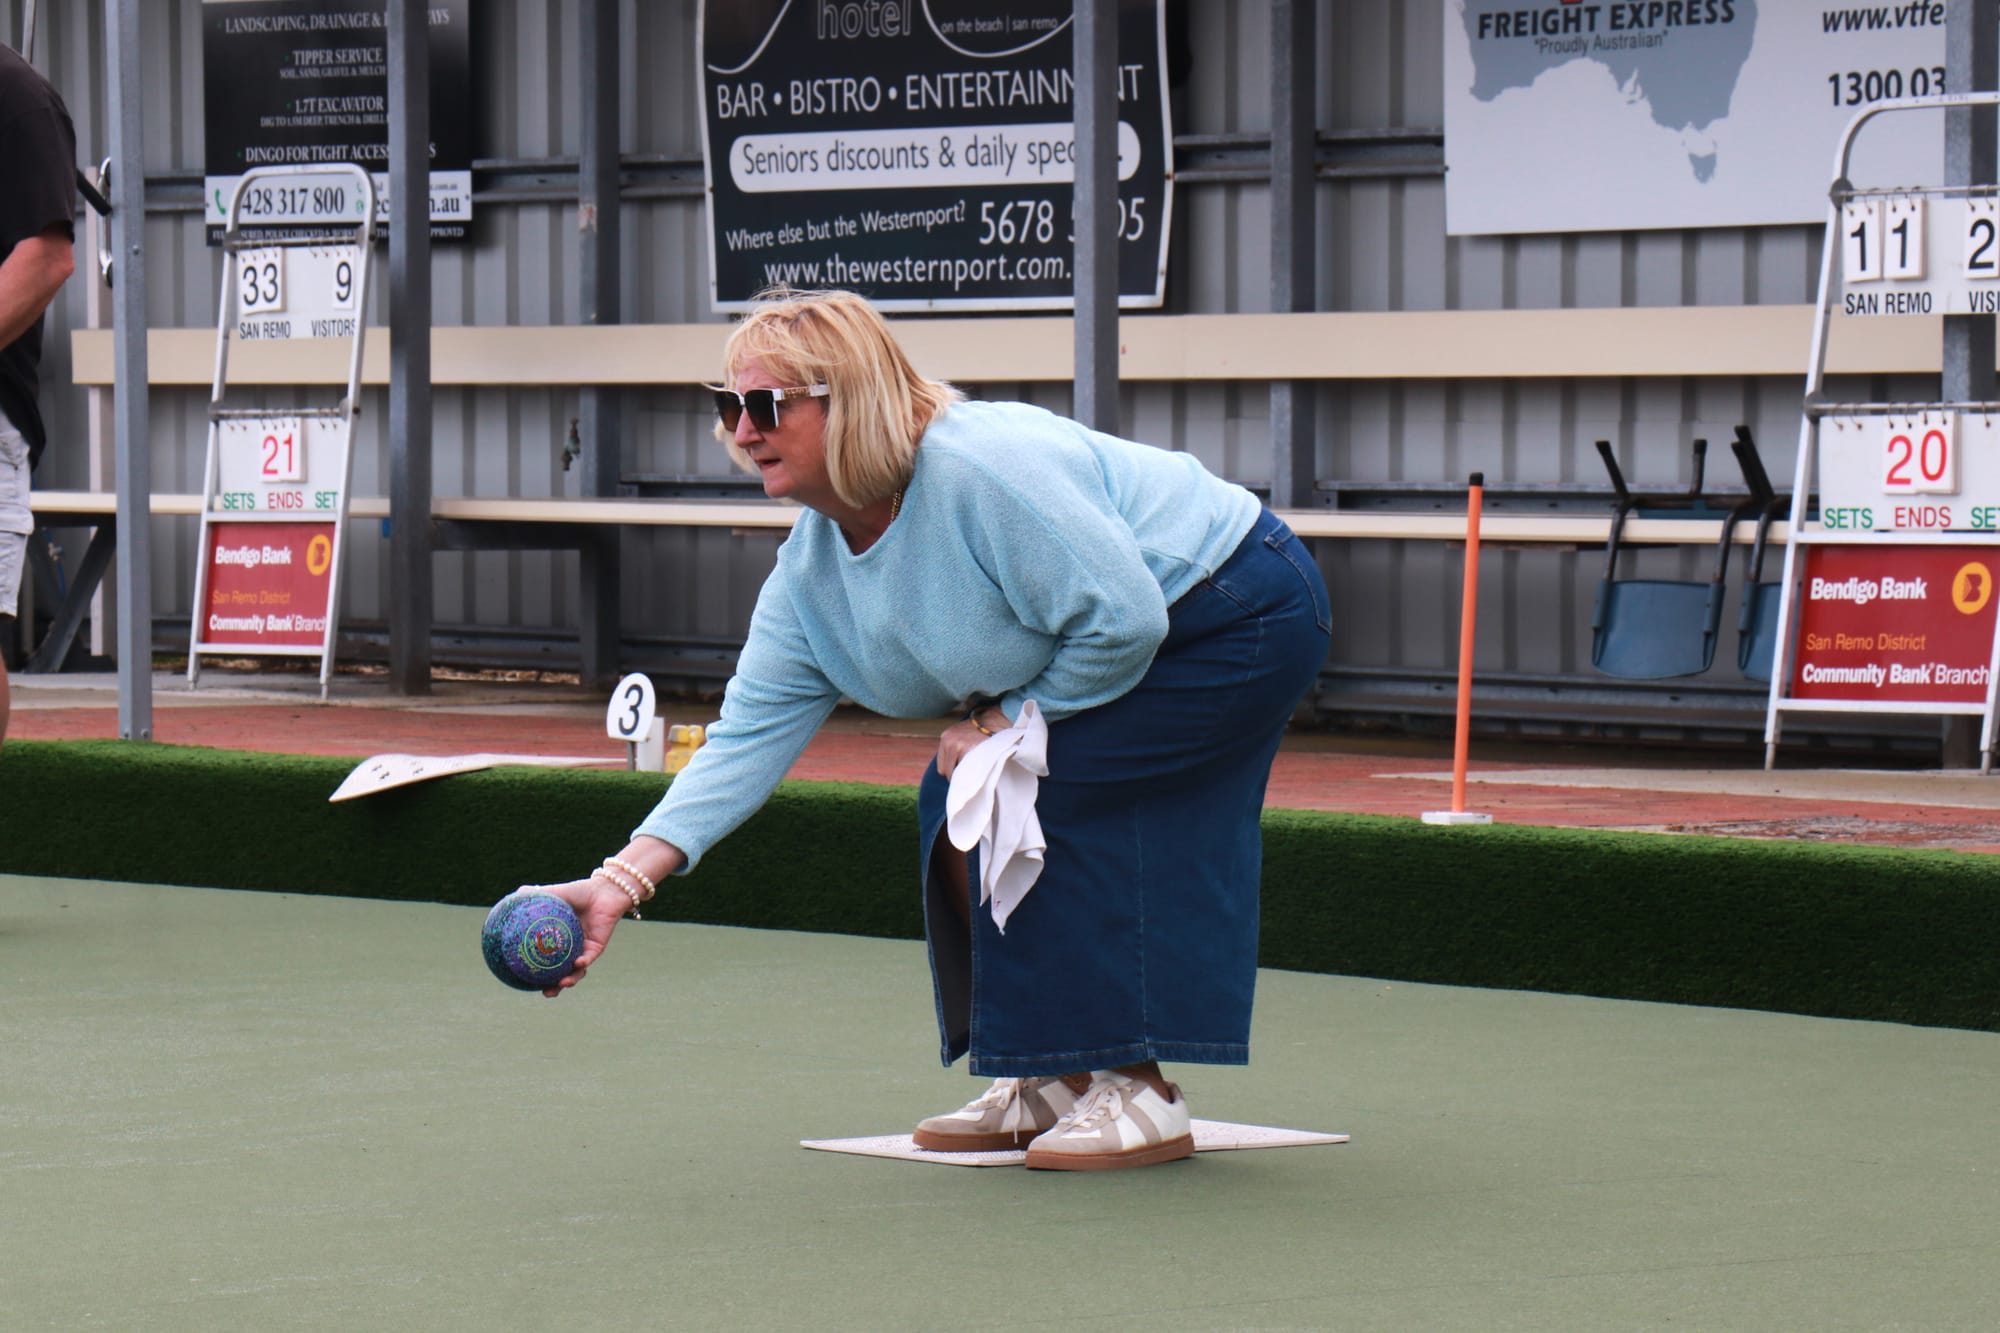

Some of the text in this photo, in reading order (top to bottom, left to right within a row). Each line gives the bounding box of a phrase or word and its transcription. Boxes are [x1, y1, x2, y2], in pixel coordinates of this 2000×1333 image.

[225, 15, 309, 33] LANDSCAPING,
[310, 12, 370, 30] DRAINAGE
[817, 0, 911, 39] hotel
[941, 17, 1058, 34] on the beach san remo
[1478, 0, 1735, 39] FREIGHT EXPRESS
[293, 48, 383, 66] TIPPER SERVICE
[717, 64, 1143, 118] BAR BISTRO ENTERTAINT
[1828, 69, 1902, 106] 1300
[318, 96, 384, 113] EXCAVATOR
[246, 147, 285, 162] DINGO
[286, 146, 309, 161] FOR
[311, 145, 348, 160] TIGHT
[743, 143, 819, 175] Seniors
[827, 139, 929, 172] discounts
[939, 136, 955, 169] &
[965, 133, 1017, 176] daily
[242, 188, 273, 215] 428
[277, 187, 308, 215] 317
[313, 187, 345, 214] 800
[726, 200, 966, 251] Where else but the Westernport?
[979, 200, 1054, 245] 5678
[1968, 218, 1995, 270] 2
[336, 261, 352, 302] 9
[764, 252, 1072, 291] www.thewesternport.com.
[243, 262, 279, 306] 33
[1845, 291, 1932, 315] SAN REMO
[1969, 291, 2000, 313] VISI
[240, 320, 291, 340] SAN REMO
[262, 433, 293, 475] 21
[1886, 429, 1947, 486] 20
[223, 492, 255, 510] SETS
[268, 491, 303, 510] ENDS
[315, 491, 338, 509] SET
[1824, 508, 1873, 529] SETS
[1894, 506, 1951, 528] ENDS
[1970, 507, 2000, 529] SE
[215, 545, 292, 568] Bendigo Bank
[212, 589, 290, 604] San Remo District
[1810, 577, 1927, 605] Bendigo Bank
[209, 614, 265, 634] Community
[1806, 633, 1926, 650] San Remo District
[1802, 662, 1886, 688] Community
[1935, 663, 1989, 685] Branch
[618, 684, 643, 736] 3
